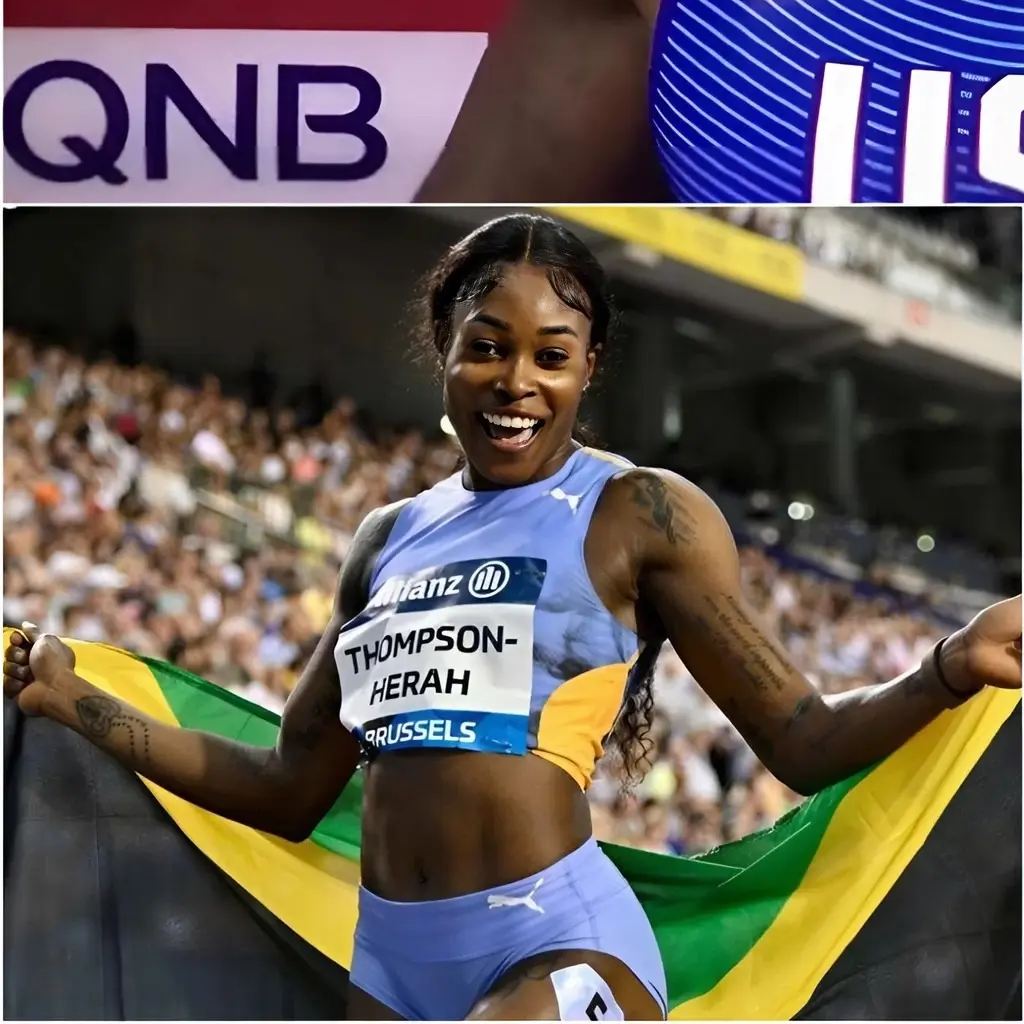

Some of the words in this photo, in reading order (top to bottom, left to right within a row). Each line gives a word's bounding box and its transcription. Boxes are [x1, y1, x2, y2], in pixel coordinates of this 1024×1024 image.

[3, 59, 389, 186] QNB
[371, 574, 465, 608] Allianz
[344, 625, 518, 675] THOMPSON-
[369, 668, 471, 706] HERAH
[364, 719, 477, 747] BRUSSELS
